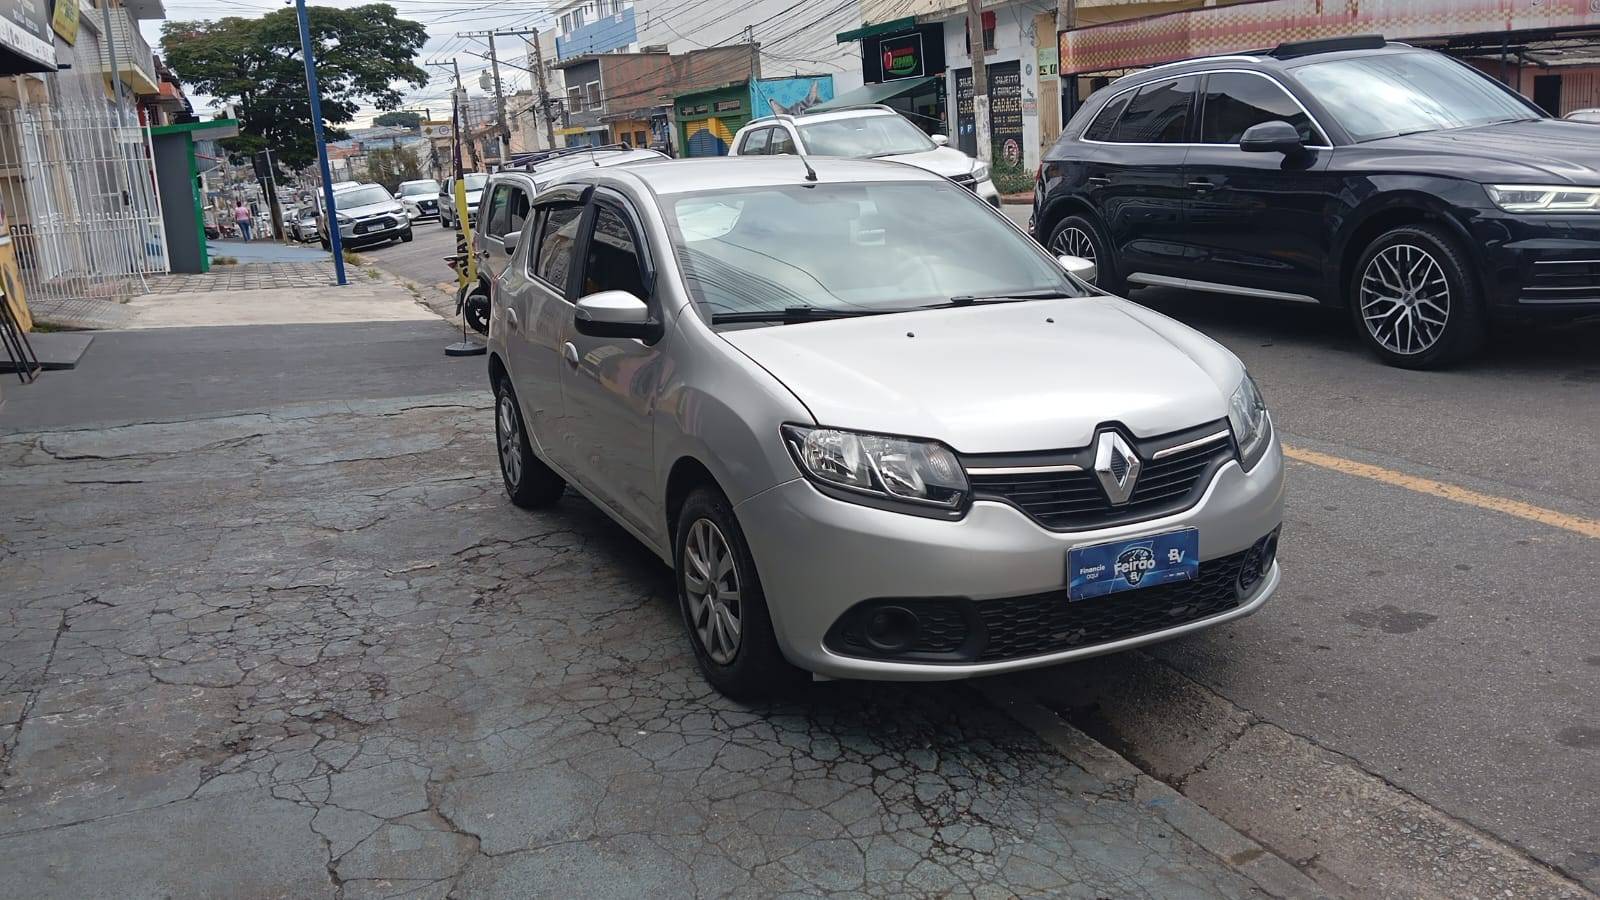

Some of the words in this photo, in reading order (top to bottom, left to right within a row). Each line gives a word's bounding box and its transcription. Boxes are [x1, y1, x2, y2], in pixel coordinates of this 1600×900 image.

[995, 74, 1019, 84] SUJEITO
[1080, 563, 1106, 575] Financie
[1114, 555, 1156, 575] Feirão
